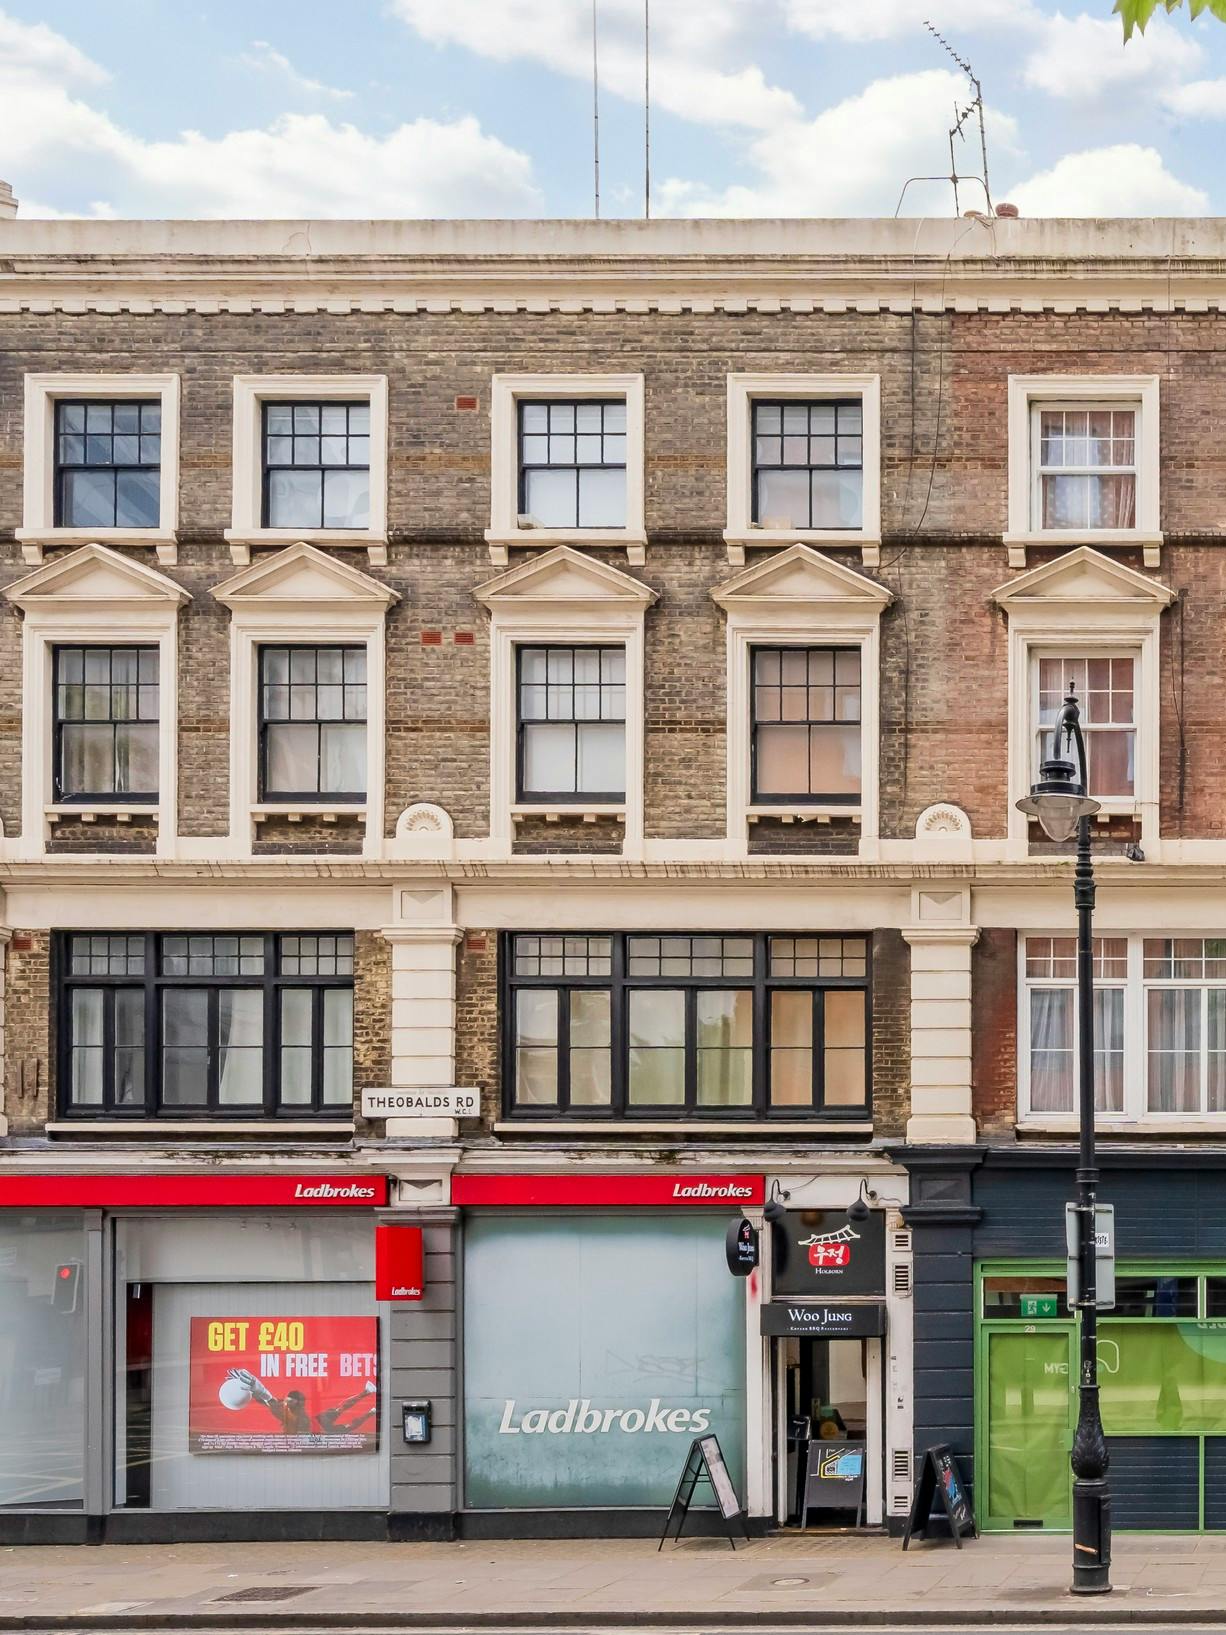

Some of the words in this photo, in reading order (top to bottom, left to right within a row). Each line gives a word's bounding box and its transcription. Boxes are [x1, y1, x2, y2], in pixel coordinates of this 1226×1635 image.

[367, 1096, 450, 1108] THEOBALDS
[456, 1096, 474, 1108] RD
[294, 1183, 376, 1198] Ladbrokes
[672, 1183, 753, 1197] Ladbrokes
[813, 1245, 845, 1265] 우정
[207, 1321, 250, 1352] GET
[258, 1321, 305, 1352] £40
[1024, 1325, 1036, 1333] 29
[260, 1353, 280, 1377] IN
[286, 1353, 329, 1377] FREE
[498, 1398, 712, 1434] Ladbrokes
